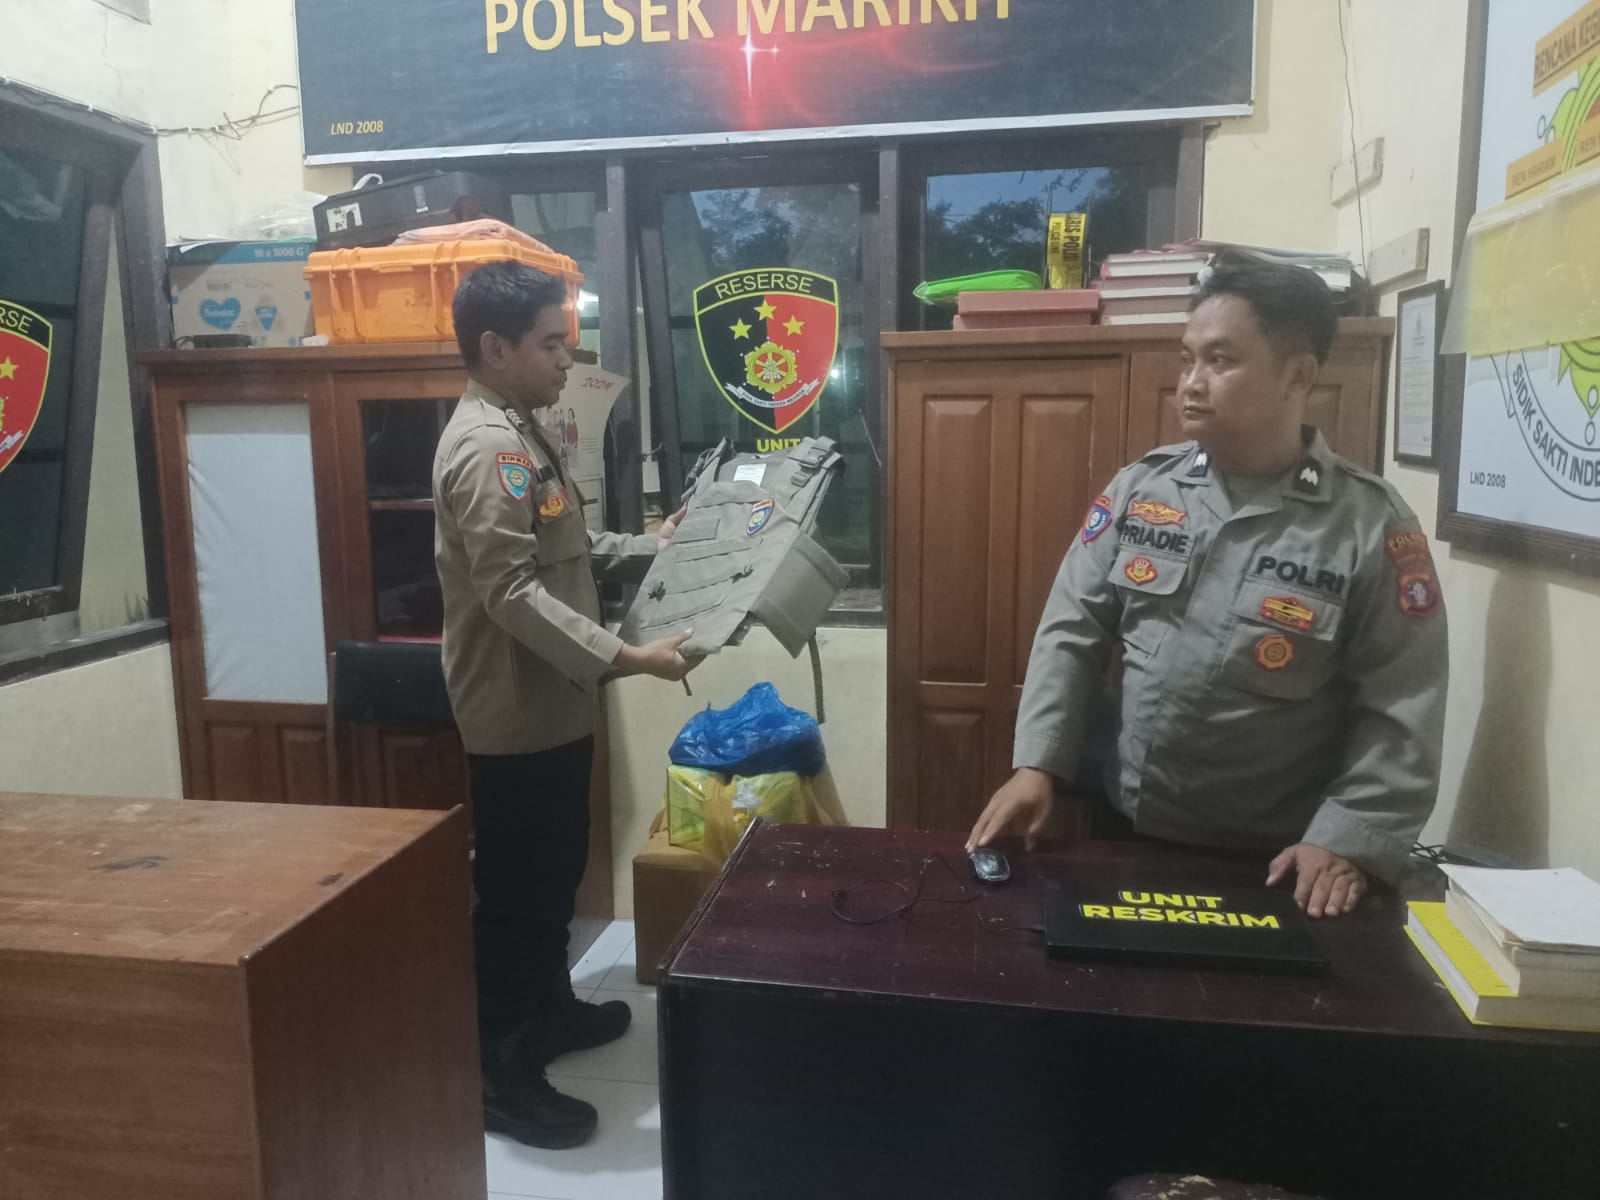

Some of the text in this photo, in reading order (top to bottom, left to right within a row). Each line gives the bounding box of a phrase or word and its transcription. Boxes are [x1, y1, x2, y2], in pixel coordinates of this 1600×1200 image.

[485, 0, 715, 53] POLSEK
[330, 120, 384, 136] LND 2008
[714, 273, 813, 299] RESERSE
[1513, 364, 1537, 430] SIDIK
[1533, 419, 1569, 477] SAKTI
[757, 439, 801, 454] UNIT
[1470, 472, 1506, 488] LND 2008
[1257, 556, 1345, 594] POLRI
[1120, 891, 1222, 908] UNIT
[1081, 904, 1280, 929] RESKRIM
